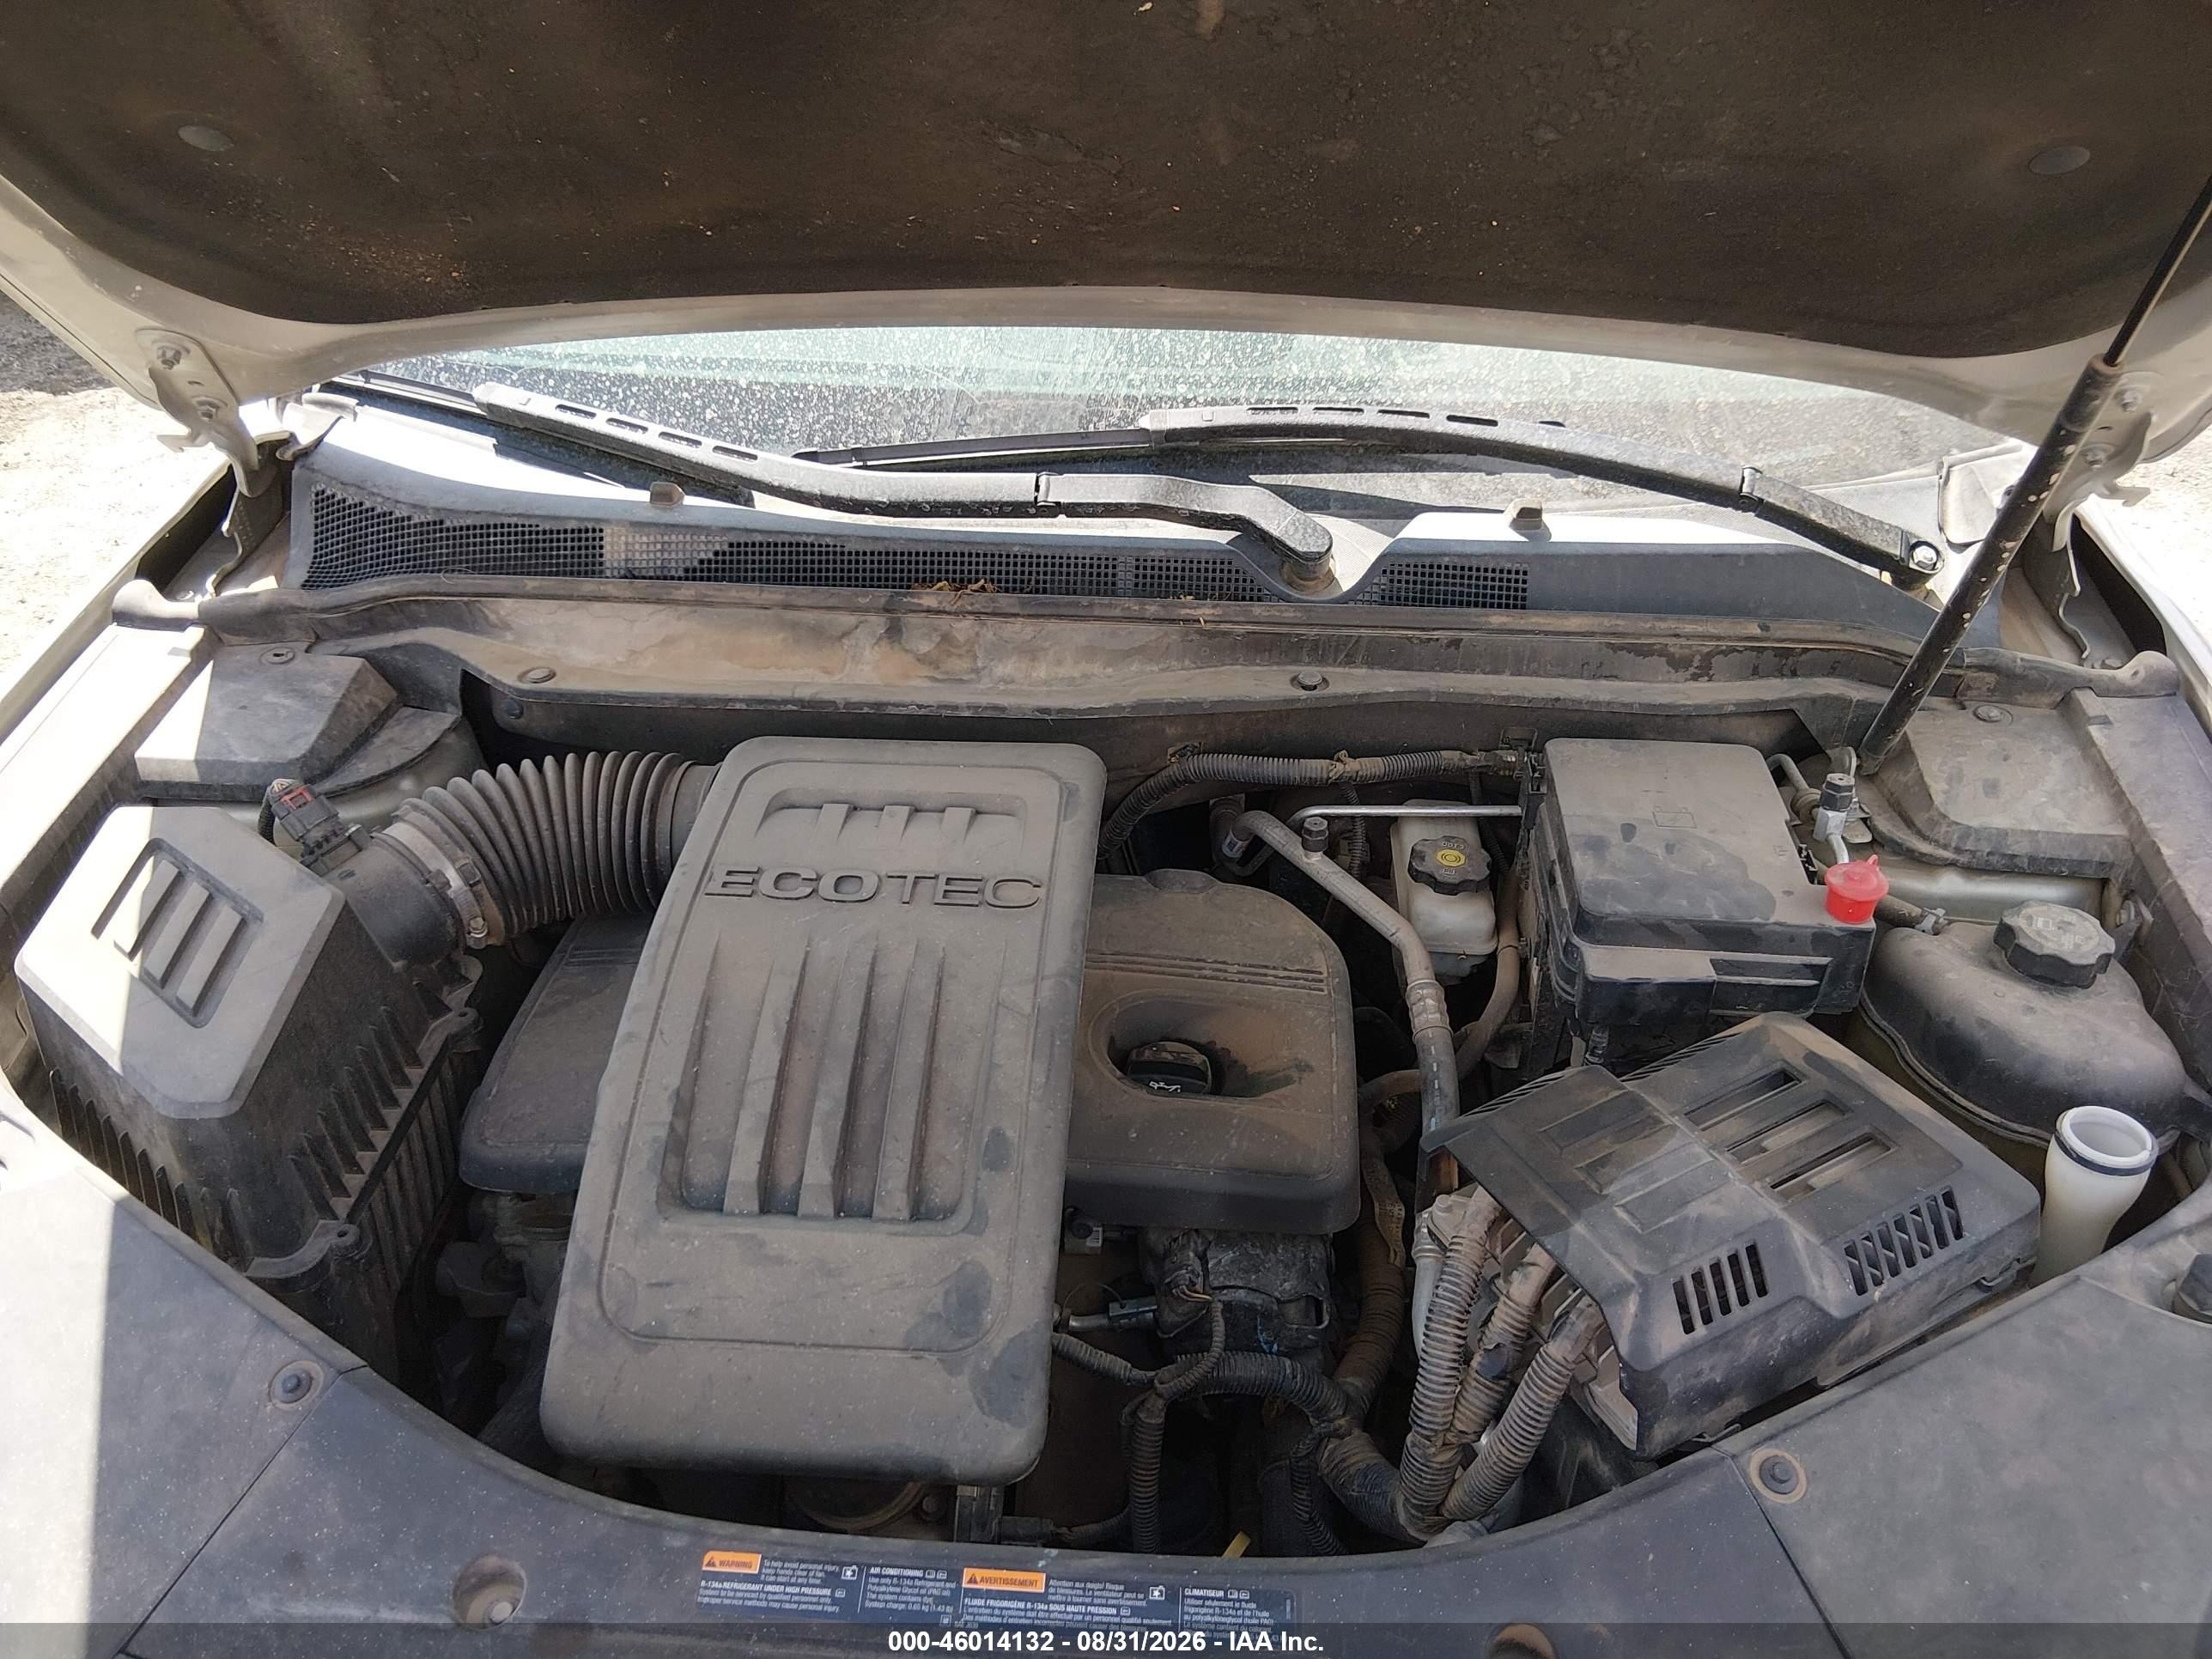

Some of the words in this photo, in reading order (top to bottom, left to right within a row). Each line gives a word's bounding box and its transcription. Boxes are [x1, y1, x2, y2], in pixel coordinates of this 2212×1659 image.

[704, 866, 1042, 909] ECOTEC
[720, 1559, 752, 1568] WARNING
[881, 1568, 924, 1577] CONDITIONING
[979, 1576, 1038, 1587] AVERTISSEMENT
[723, 1582, 763, 1591] REFRIGERANT
[800, 1587, 832, 1595] PRESSURE
[1184, 1588, 1224, 1597] CLIMATISEUR
[1087, 1606, 1116, 1614] PRESSION
